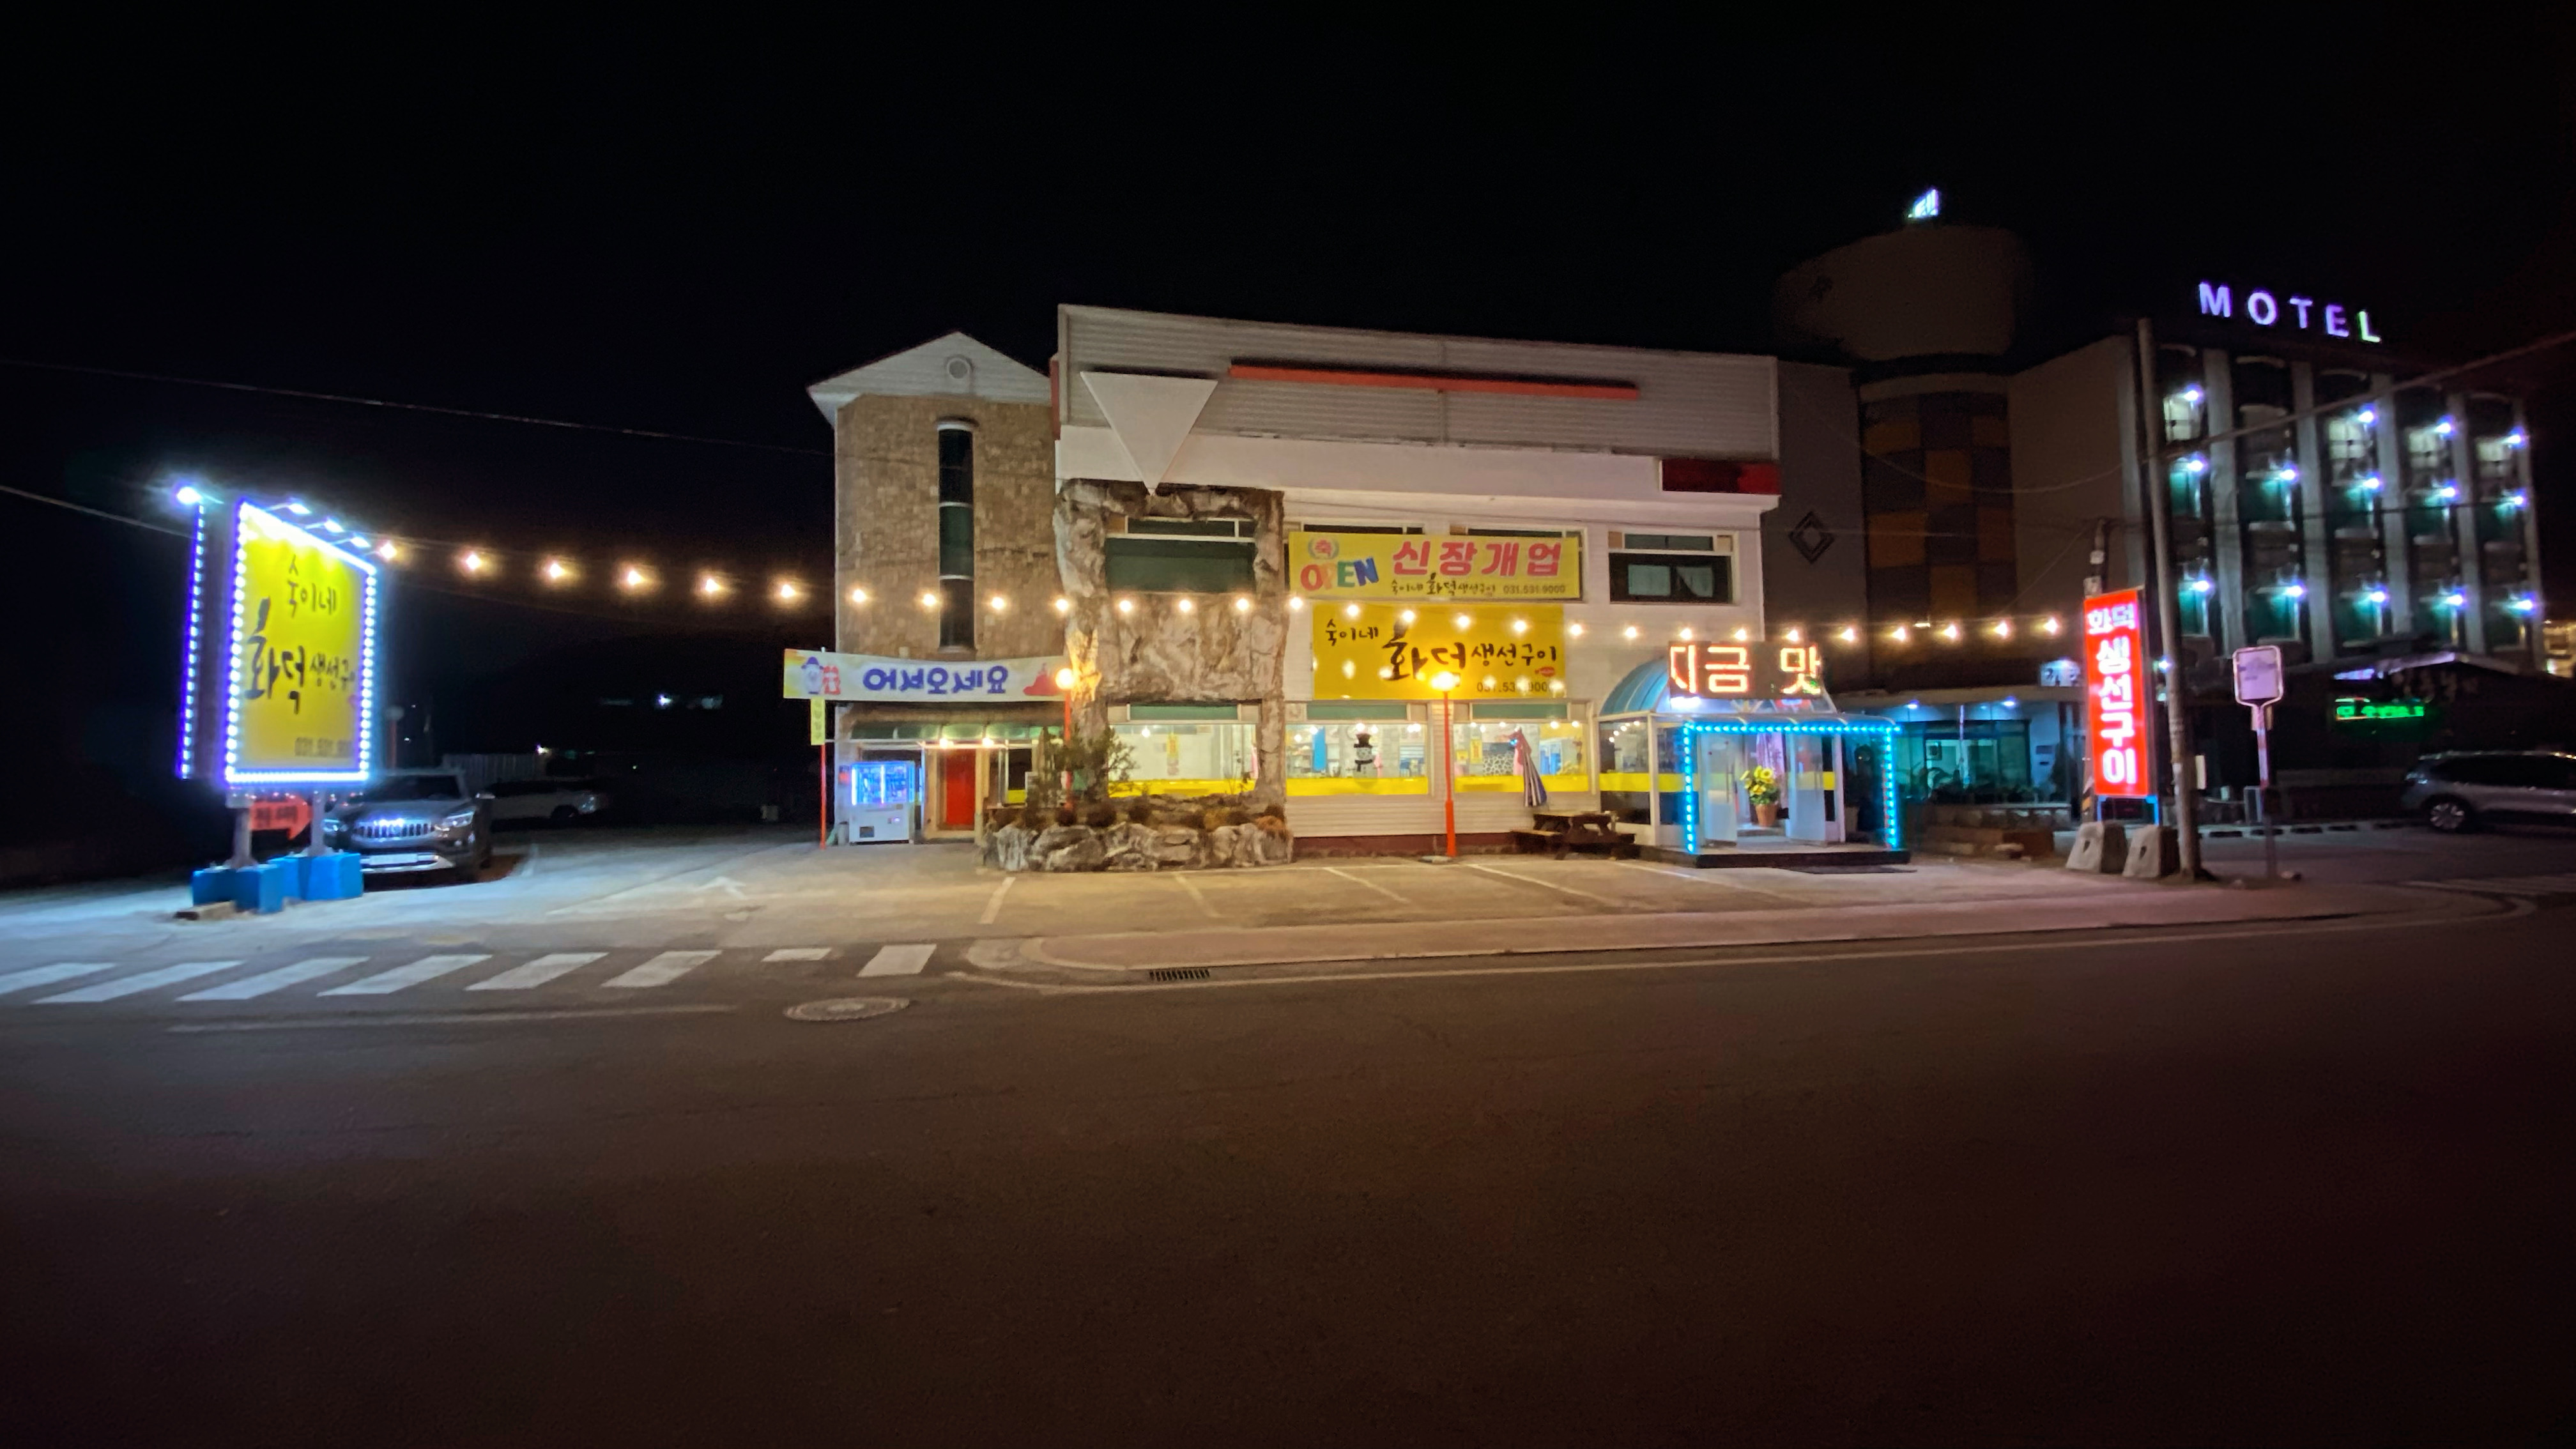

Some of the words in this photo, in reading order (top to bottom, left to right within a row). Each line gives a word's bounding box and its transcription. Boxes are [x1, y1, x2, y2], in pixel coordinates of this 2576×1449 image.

[2198, 281, 2382, 343] MOTEL
[1300, 556, 1379, 592] OPEN
[1392, 540, 1561, 576] 신장개업
[288, 554, 337, 618] 숙이네
[1324, 618, 1379, 647] 숙이네
[2087, 603, 2136, 634] 화덕
[1471, 643, 1557, 667] 생선구이
[1780, 645, 1821, 694] 맛
[862, 665, 1008, 694] 어서오세요
[2096, 636, 2137, 785] 생선구이
